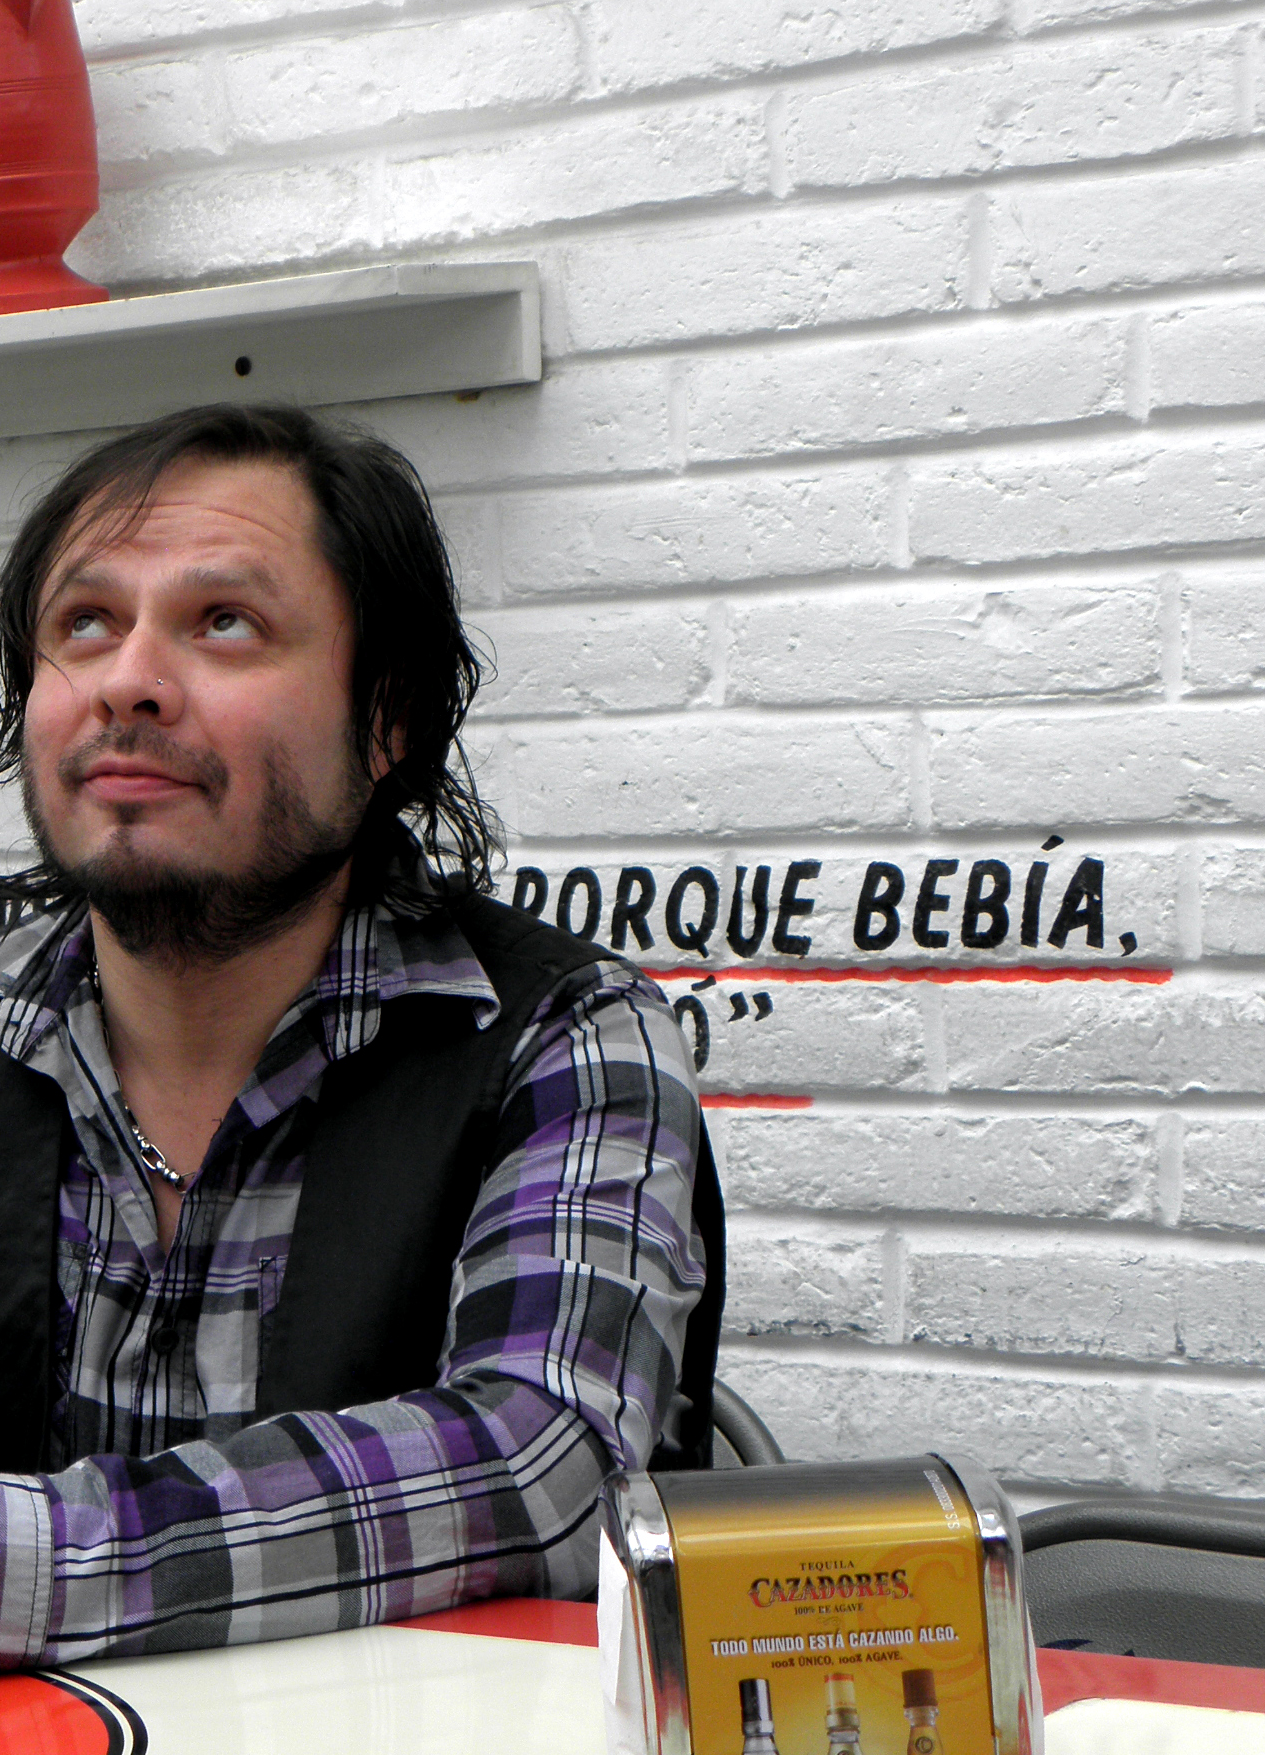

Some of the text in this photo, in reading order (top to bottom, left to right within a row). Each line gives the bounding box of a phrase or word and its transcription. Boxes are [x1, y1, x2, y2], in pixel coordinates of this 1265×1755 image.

[512, 860, 823, 959] PORQUE
[853, 834, 1138, 958] BEBÍA,
[799, 1560, 856, 1572] TEQUILA
[748, 1568, 911, 1609] CAZADORES
[794, 1606, 816, 1616] 100%
[834, 1602, 865, 1613] AGAVE
[711, 1624, 960, 1657] TODO MUNDO ESTÁ CAZANDO ALGO.
[771, 1649, 904, 1669] 100% ÚNICO, 100% AGAVE.
